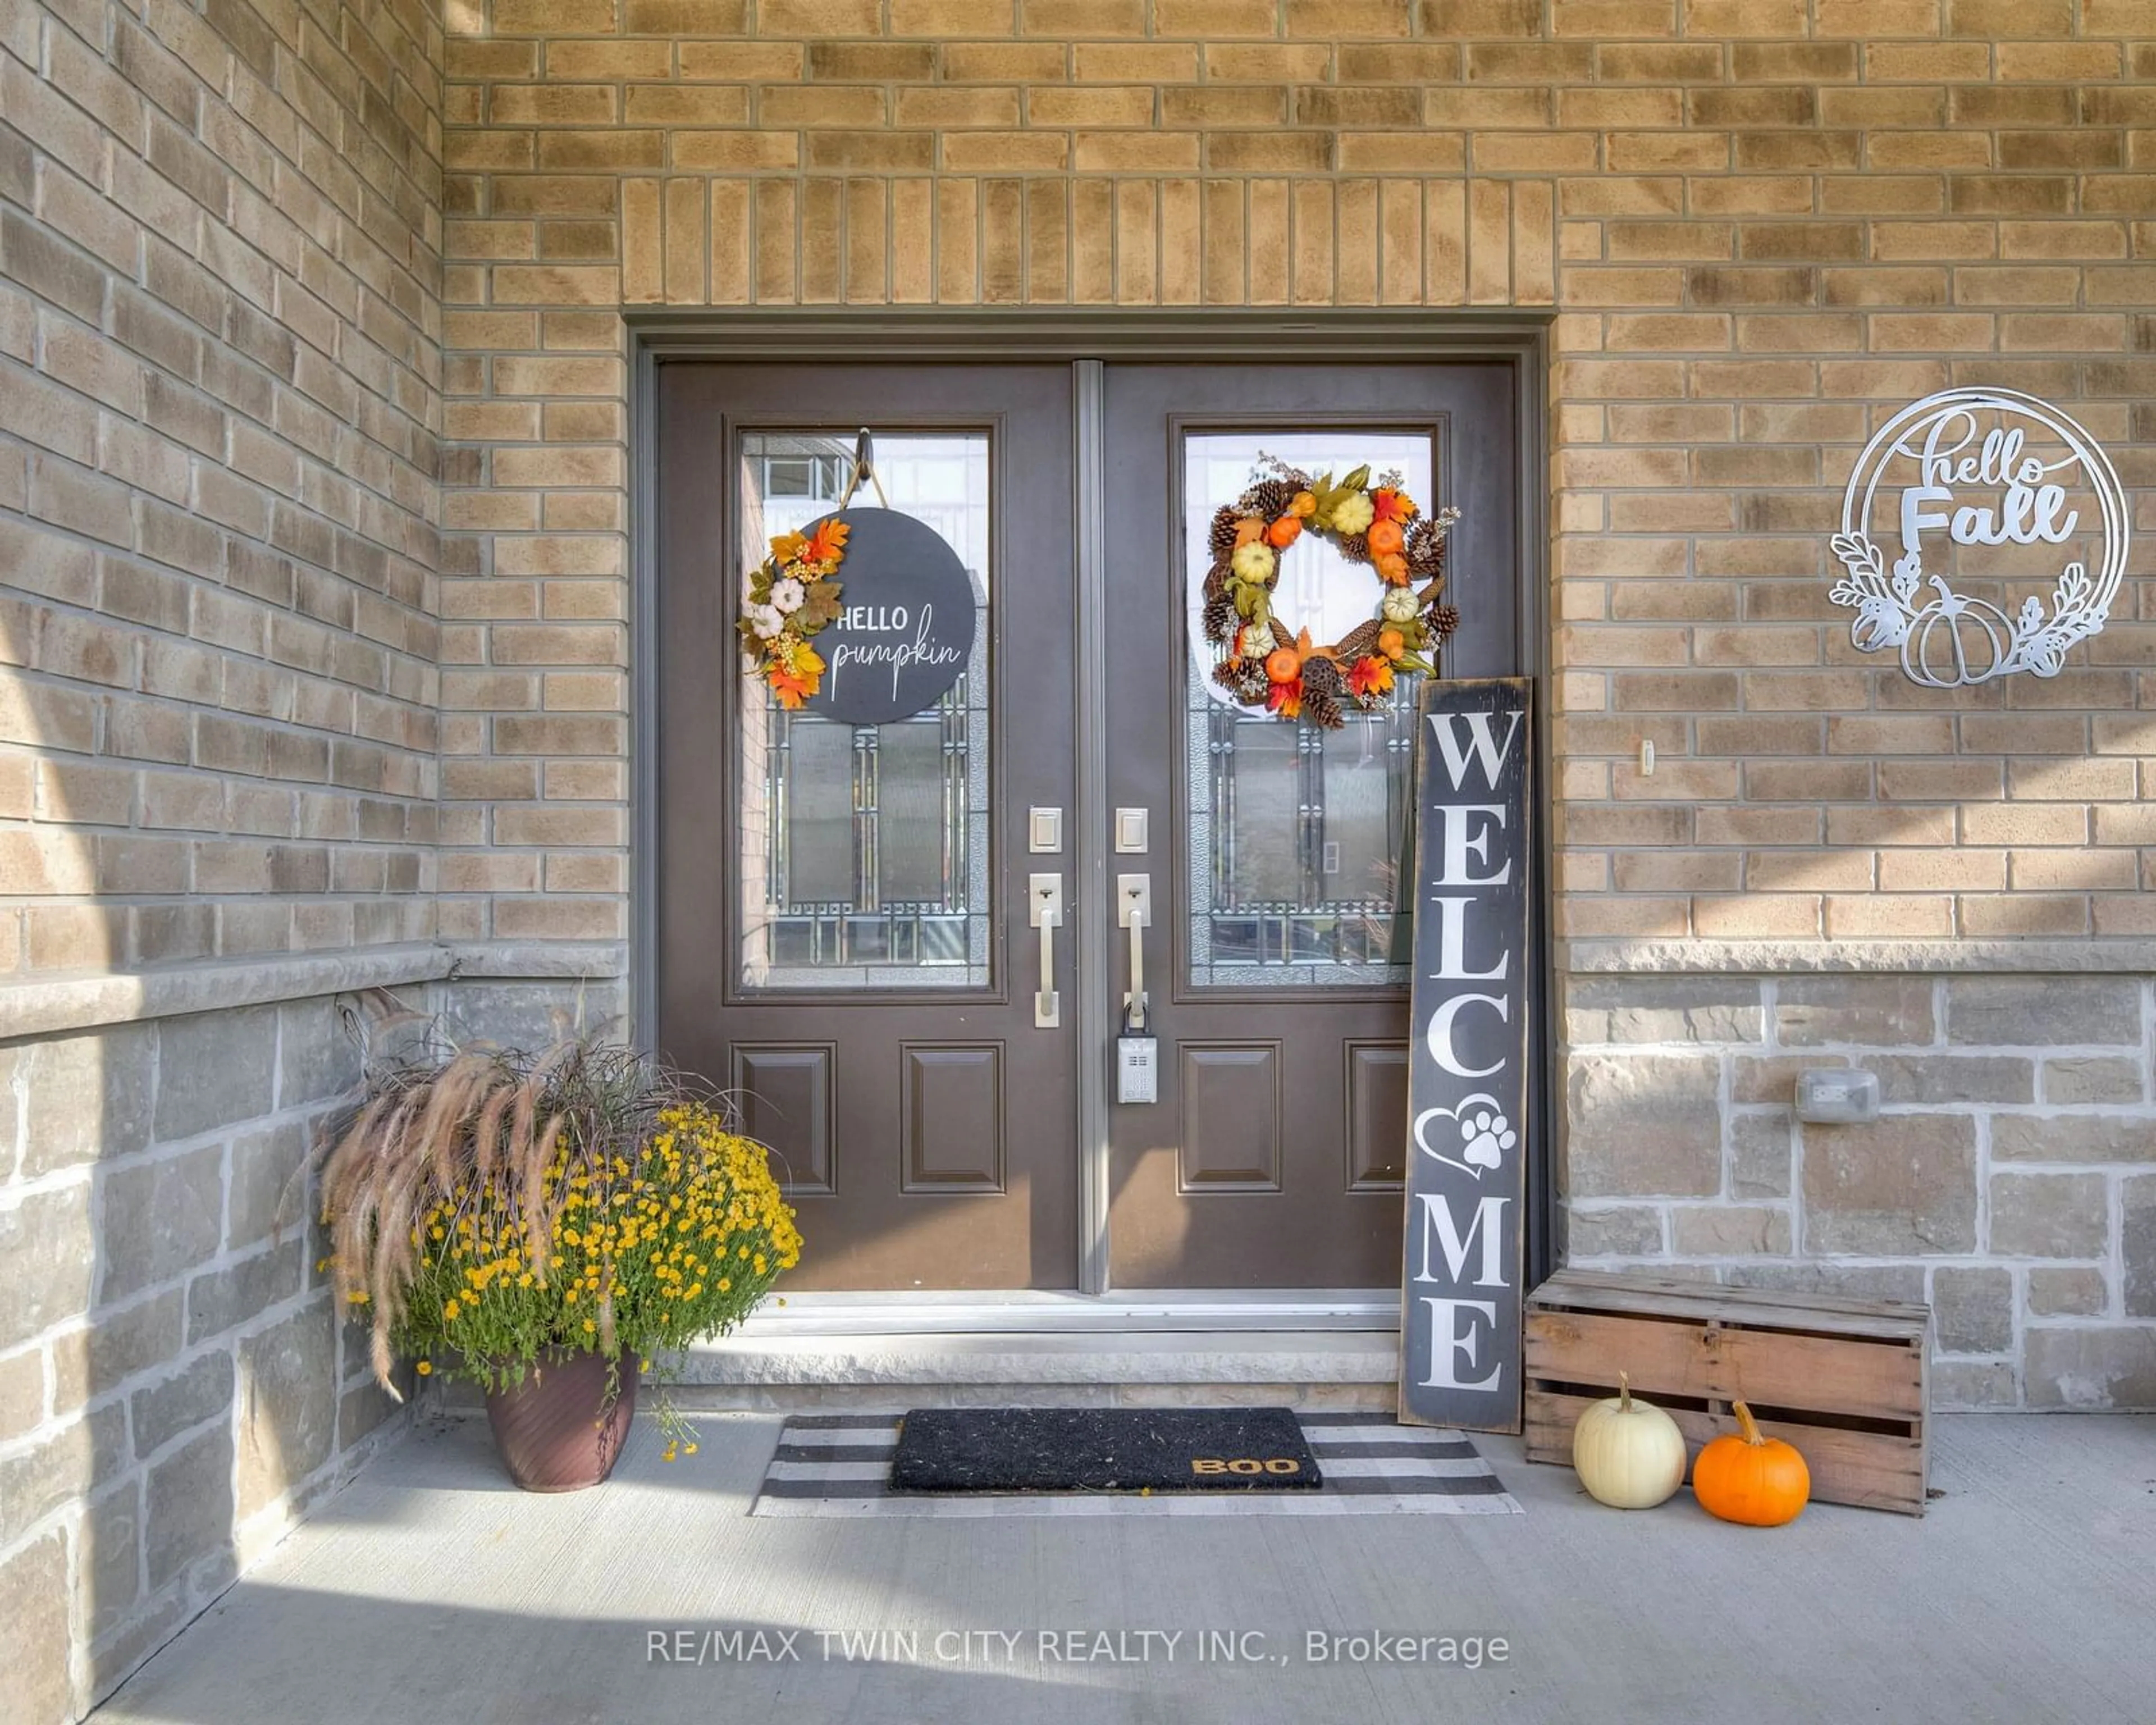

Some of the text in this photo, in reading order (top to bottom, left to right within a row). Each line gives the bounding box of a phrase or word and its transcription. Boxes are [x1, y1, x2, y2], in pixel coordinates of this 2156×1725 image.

[1921, 411, 2043, 487] hello
[1902, 485, 2077, 552] Fall
[837, 606, 908, 631] HELLO
[831, 604, 961, 702] pumpkin
[1192, 1459, 1300, 1474] BOO
